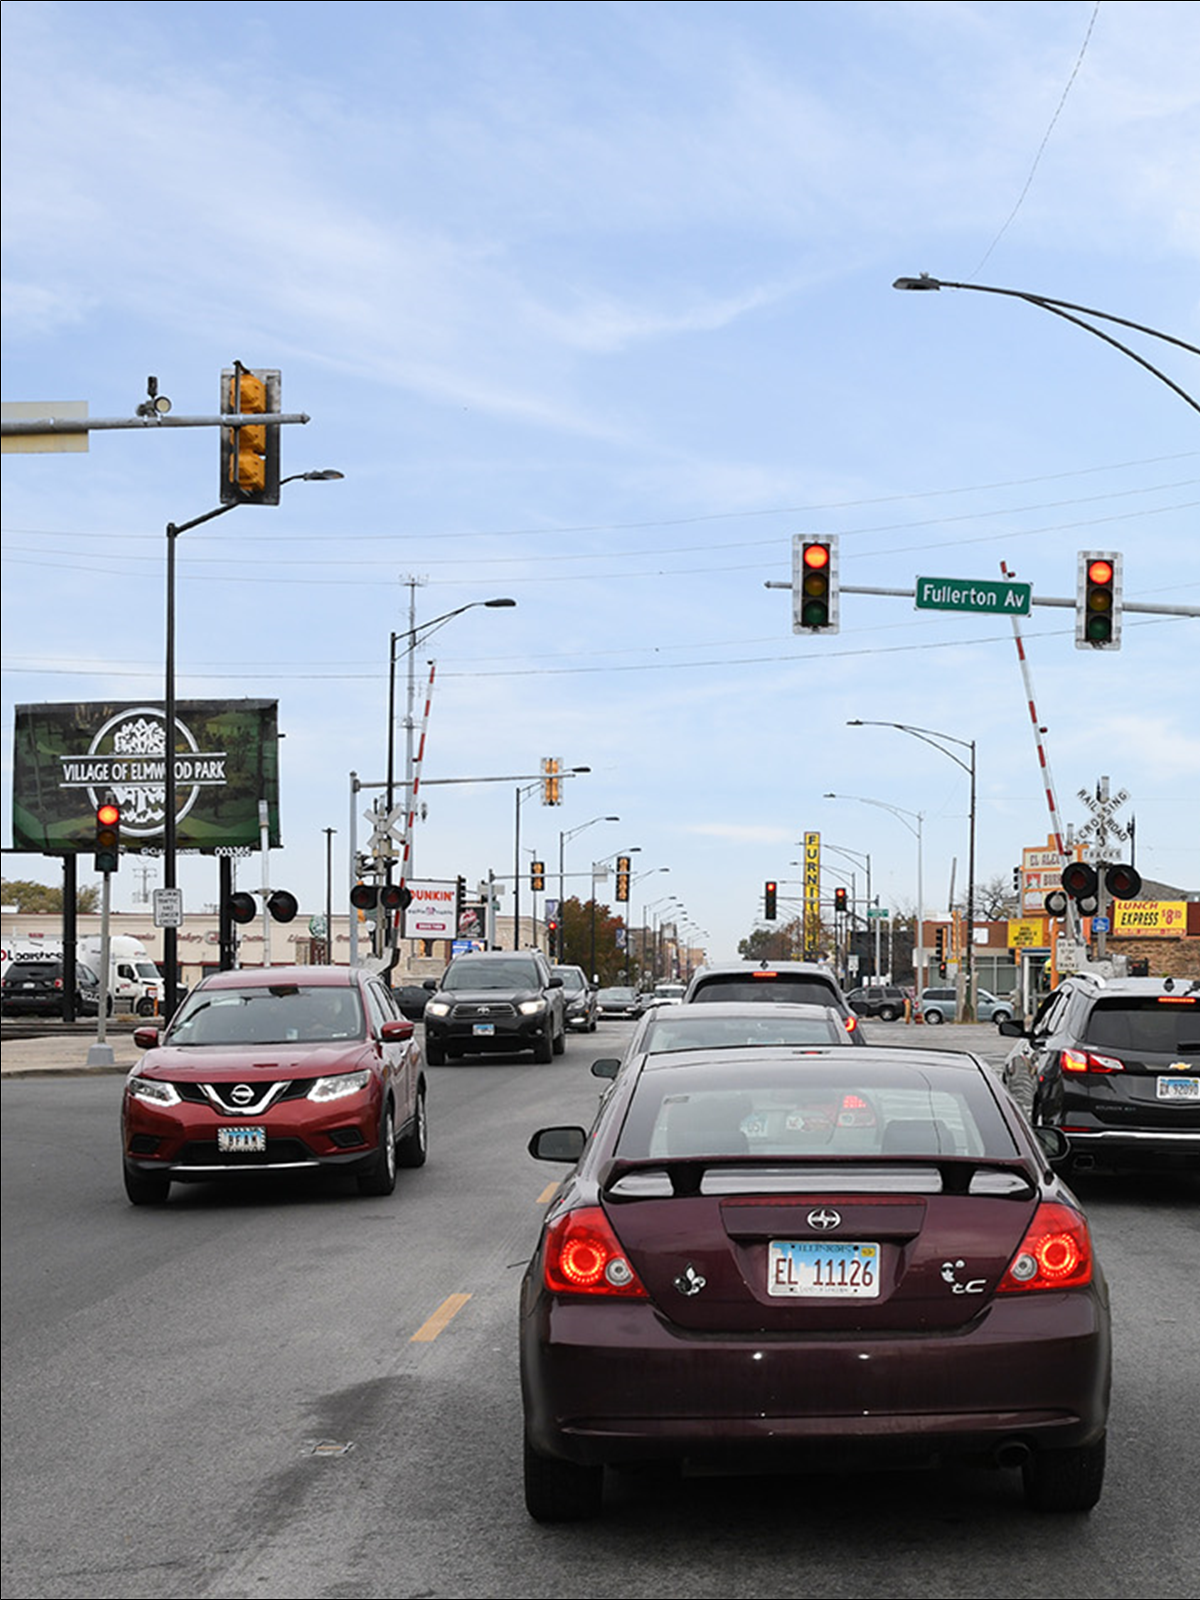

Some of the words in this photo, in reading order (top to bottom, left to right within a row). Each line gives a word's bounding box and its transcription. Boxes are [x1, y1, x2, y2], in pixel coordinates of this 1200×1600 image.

[922, 583, 997, 606] Fullerton
[1004, 589, 1025, 608] Av
[62, 763, 109, 781] VILLAGE
[111, 763, 128, 781] OF
[131, 761, 192, 781] ELMWOD
[194, 761, 226, 779] PARK
[1078, 792, 1127, 839] CROSSING
[806, 835, 818, 952] FURNITURE
[1117, 902, 1159, 910] LUNCH
[1121, 912, 1159, 926] EXPRESS
[775, 1258, 798, 1285] EL
[813, 1259, 873, 1287] 11126
[952, 1279, 987, 1294] tC
